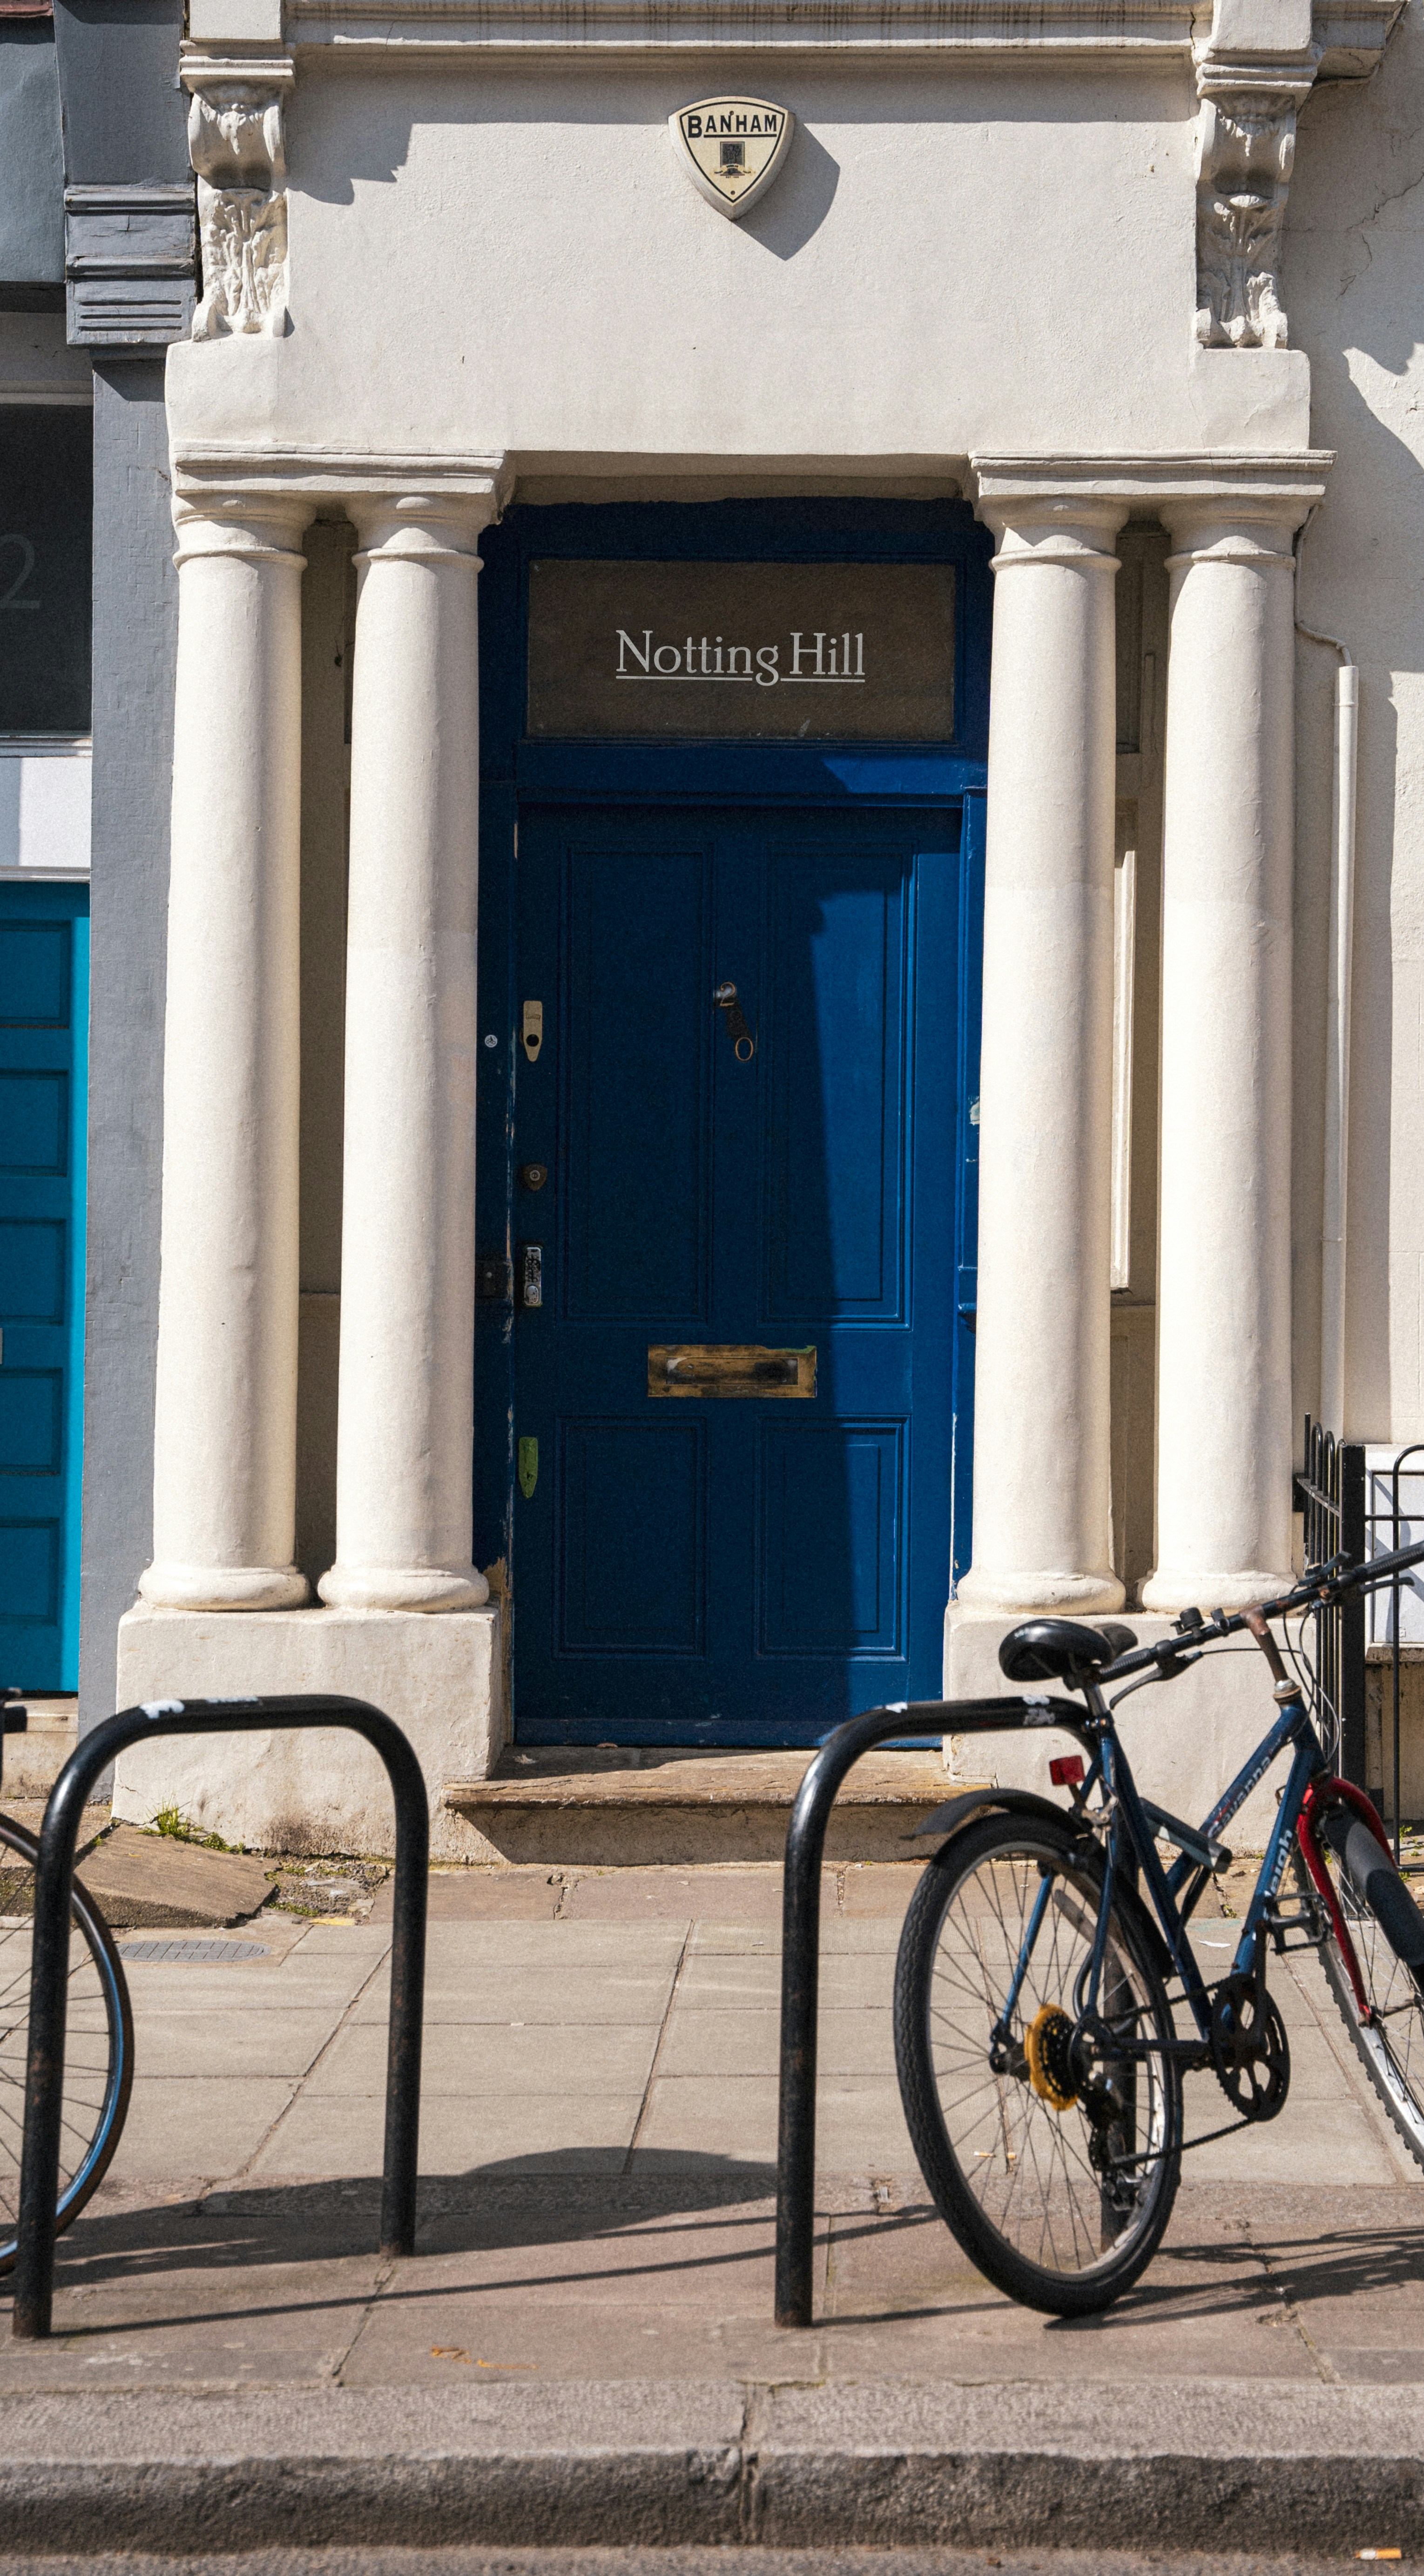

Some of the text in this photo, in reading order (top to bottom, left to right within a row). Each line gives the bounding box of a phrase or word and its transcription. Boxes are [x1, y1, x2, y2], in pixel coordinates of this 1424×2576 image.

[688, 115, 777, 138] BANHAM
[615, 630, 865, 686] Notting Hill
